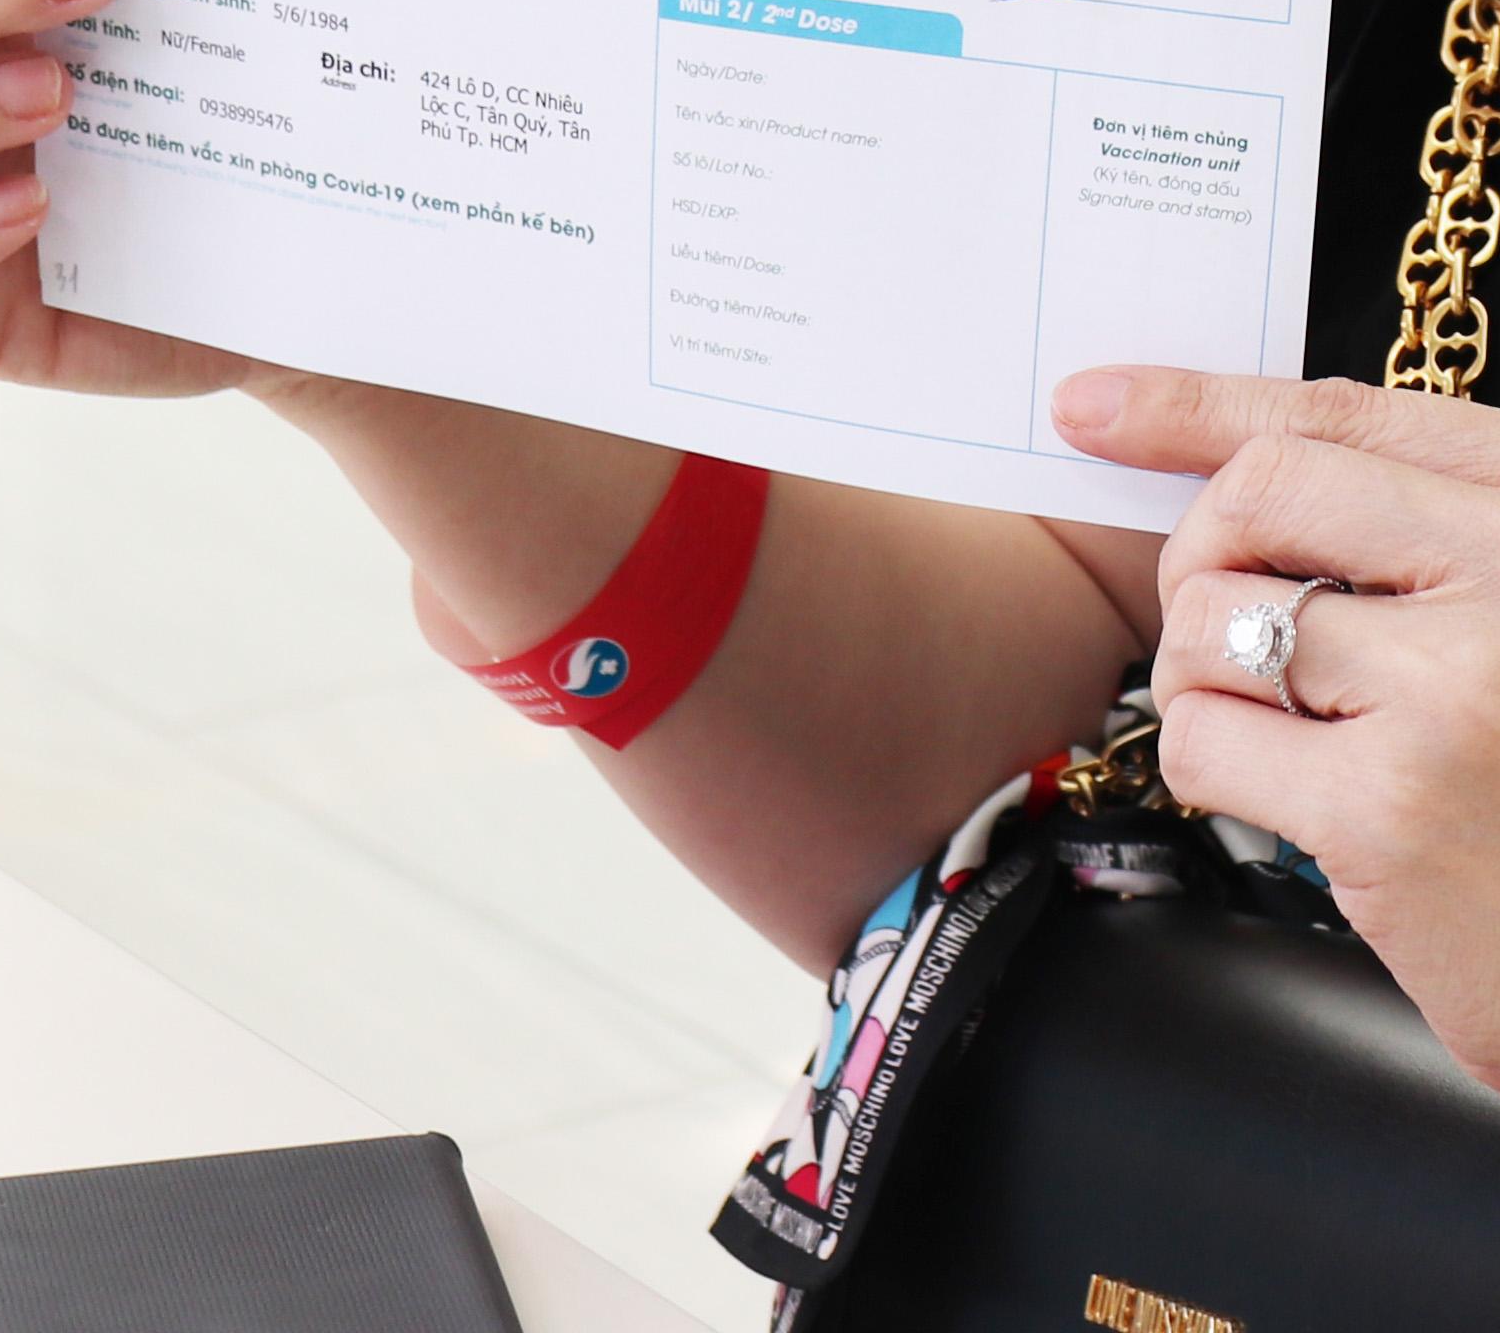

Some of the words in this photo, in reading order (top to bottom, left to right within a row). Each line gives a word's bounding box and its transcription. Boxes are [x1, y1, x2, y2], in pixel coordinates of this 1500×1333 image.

[102, 20, 140, 41] tính:
[274, 3, 348, 32] 5/6/1984
[727, 0, 753, 22] 2/
[761, 4, 796, 27] 2nd
[798, 9, 859, 35] Dose
[161, 30, 245, 62] Nữ/Female
[321, 52, 352, 76] Địa
[90, 70, 128, 92] điện
[134, 78, 183, 103] thoại:
[420, 71, 450, 90] 424
[457, 77, 476, 95] Lô
[483, 82, 499, 103] D,
[506, 86, 529, 105] CC
[536, 91, 582, 114] Nhiêu
[200, 98, 293, 133] 0938995476
[421, 95, 448, 116] Lộc
[454, 101, 470, 122] C,
[476, 105, 507, 125] Tân
[514, 113, 552, 137] Quý,
[559, 120, 590, 141] Tân
[421, 119, 451, 140] Phú
[457, 126, 482, 147] Tp.
[491, 133, 527, 154] HCM
[1093, 117, 1126, 133] Đơn
[1133, 124, 1145, 140] vị
[1152, 125, 1188, 141] tiêm
[1195, 132, 1248, 152] chủng
[1102, 143, 1202, 167] Vaccination
[1208, 159, 1240, 172] unit
[67, 114, 90, 134] Đã
[96, 123, 140, 146] được
[146, 133, 184, 154] tiêm
[191, 141, 222, 163] vắc
[229, 154, 254, 170] xin
[261, 161, 317, 189] phòng
[323, 173, 405, 202] Covid-19
[412, 192, 460, 213] (xem
[467, 202, 514, 224] phần
[522, 212, 545, 230] kế
[550, 218, 594, 244] bên)
[826, 1180, 858, 1232] LOVE
[843, 1065, 897, 1176] MOSCHINO
[886, 1015, 919, 1069] LOVE
[905, 909, 978, 1015] MOSCHINO
